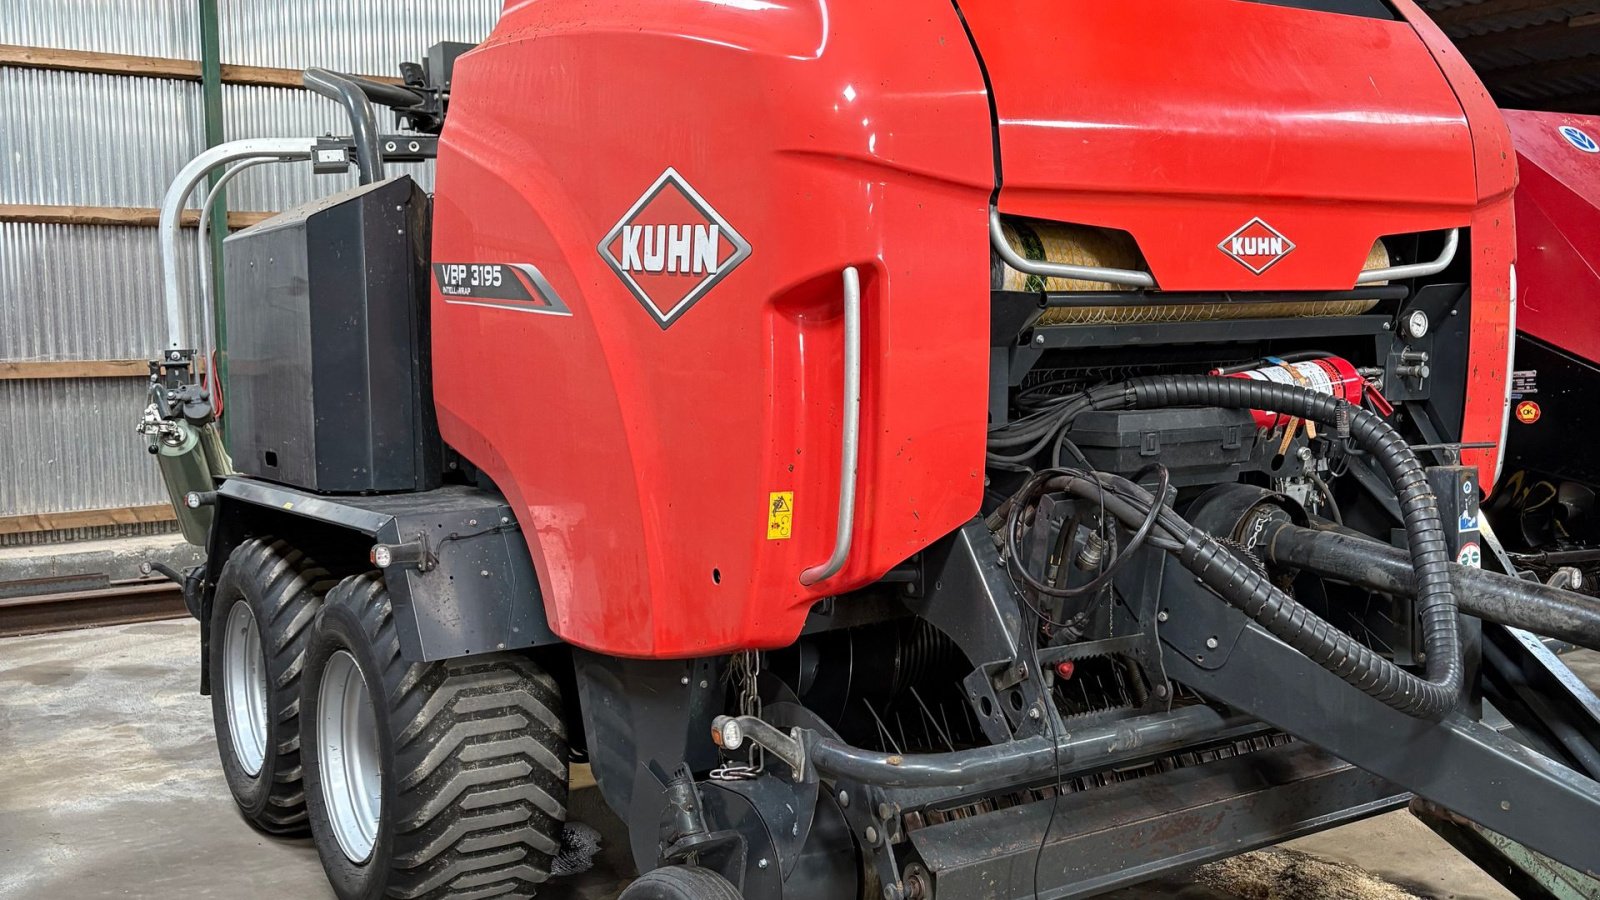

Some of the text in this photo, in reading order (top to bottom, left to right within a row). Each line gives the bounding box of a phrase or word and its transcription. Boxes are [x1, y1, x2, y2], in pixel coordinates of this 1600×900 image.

[621, 224, 719, 274] KUHN
[1232, 237, 1282, 255] KUHN
[442, 264, 502, 287] VBP 3195
[1522, 408, 1533, 416] OK
